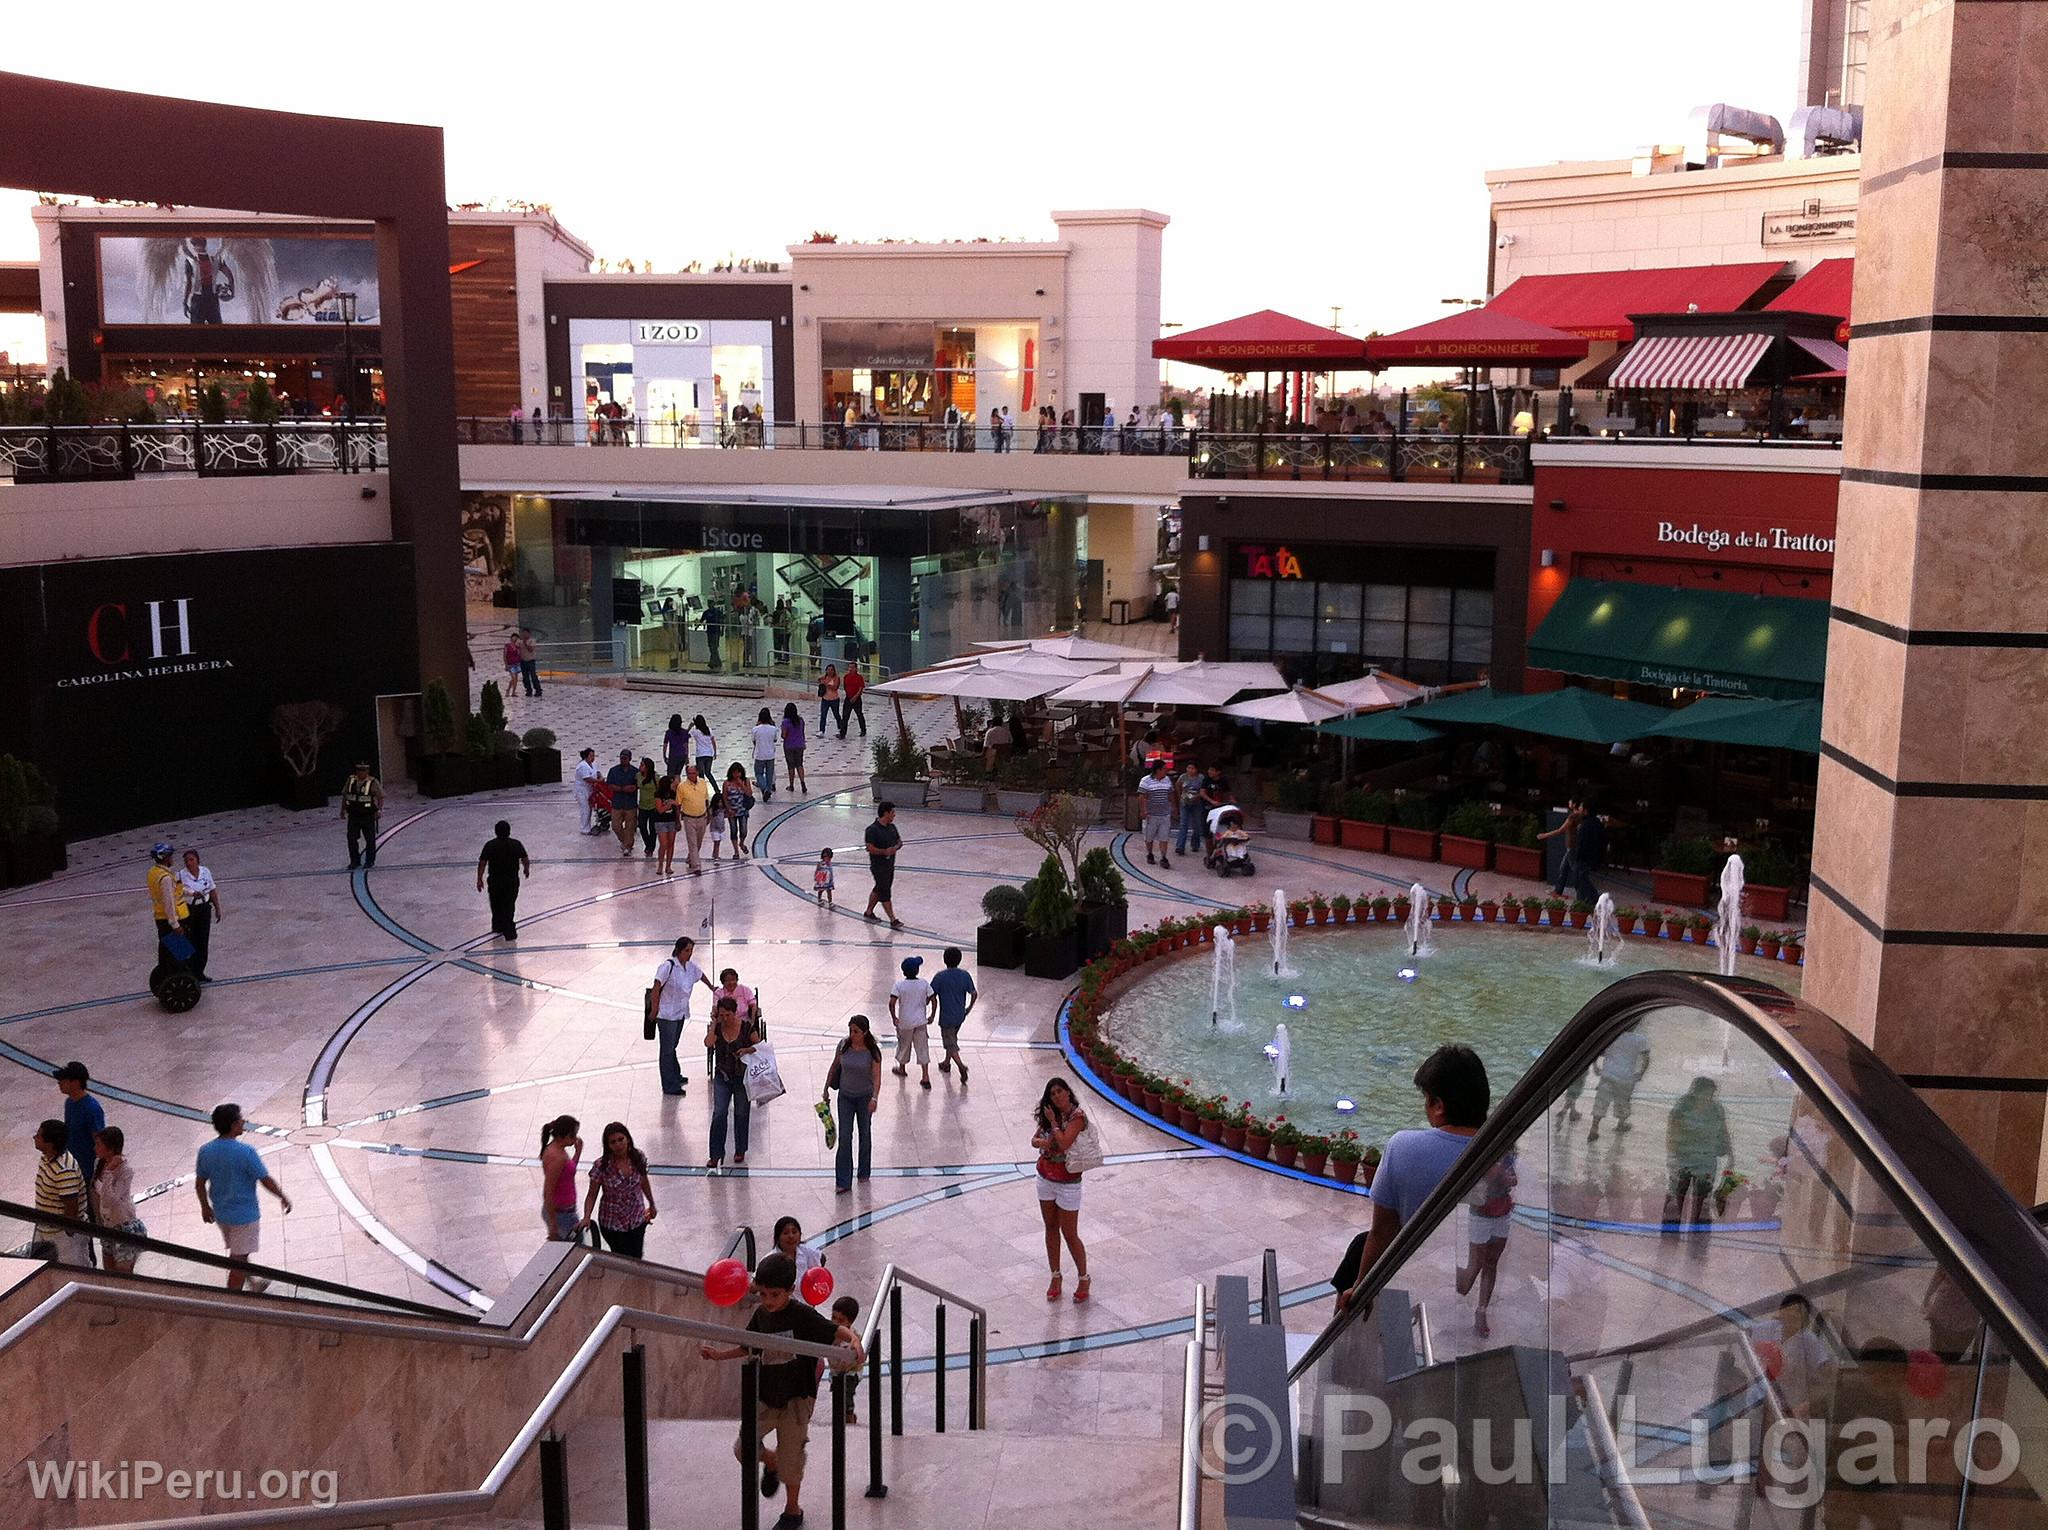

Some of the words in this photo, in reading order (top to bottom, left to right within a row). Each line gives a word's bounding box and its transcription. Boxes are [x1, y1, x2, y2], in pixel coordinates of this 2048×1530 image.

[640, 325, 698, 340] IZOD
[1196, 345, 1214, 355] LA
[1218, 343, 1317, 355] BONBONNIERE
[1415, 344, 1432, 354] LA
[1438, 343, 1539, 355] BONBONNIERE
[702, 526, 763, 548] iStore
[1657, 521, 1730, 551] Bodega
[1735, 531, 1752, 547] de
[1755, 532, 1768, 548] la
[57, 670, 144, 688] CAROLINA
[148, 659, 235, 677] HERRERA
[1641, 666, 1677, 685] Bodega
[1679, 672, 1690, 683] de
[1693, 673, 1702, 685] la
[1703, 674, 1748, 691] Trattoria
